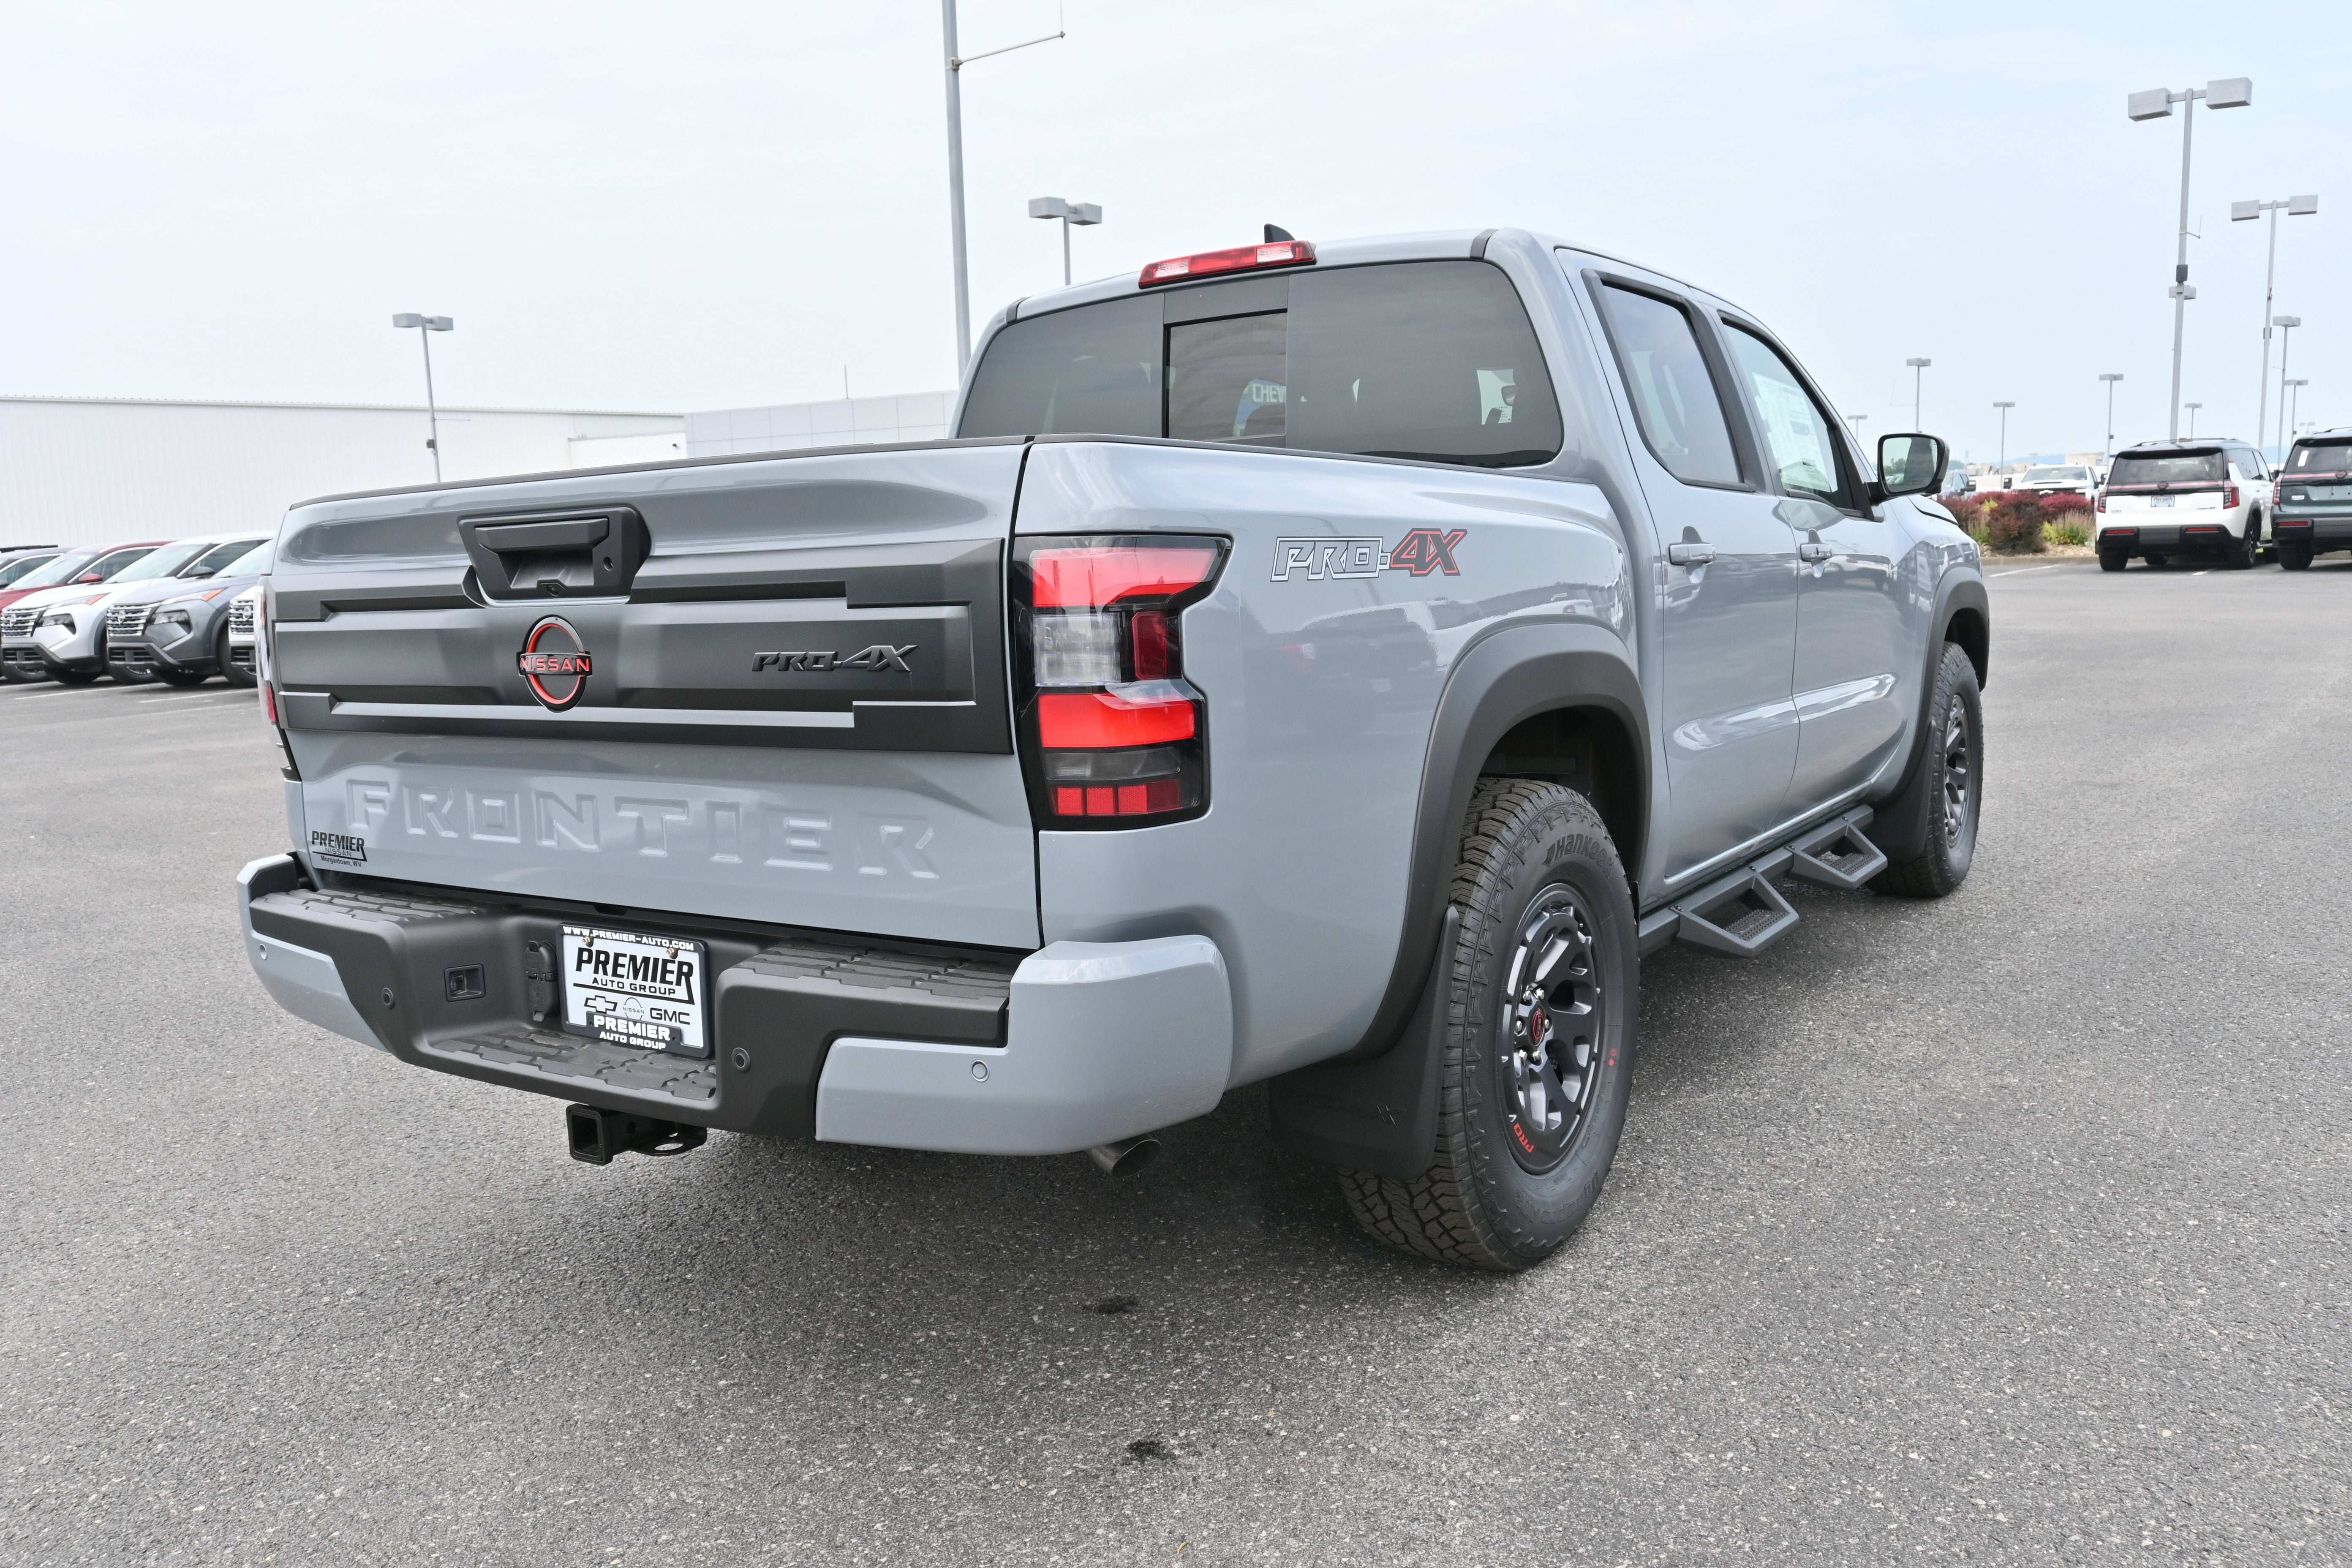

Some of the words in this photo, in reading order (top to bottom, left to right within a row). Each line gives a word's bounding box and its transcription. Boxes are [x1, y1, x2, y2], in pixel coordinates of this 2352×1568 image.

[520, 657, 590, 671] NISSAN
[346, 778, 939, 879] FRONTIER
[312, 830, 365, 852] PREMIER
[321, 855, 352, 867] Morgantown,
[325, 847, 351, 857] NISSAN
[563, 926, 694, 950] WWW.PREMIER-AUTO.COM
[575, 947, 694, 987] PREMIER
[592, 977, 625, 989] AUTO
[629, 983, 676, 996] GROUP
[622, 1006, 645, 1014] NISSAN
[650, 1007, 691, 1025] GMC
[593, 1015, 671, 1041] PREMIER
[599, 1031, 627, 1043] AUTO
[629, 1037, 667, 1050] GROUP
[1514, 1123, 1535, 1153] PRO
